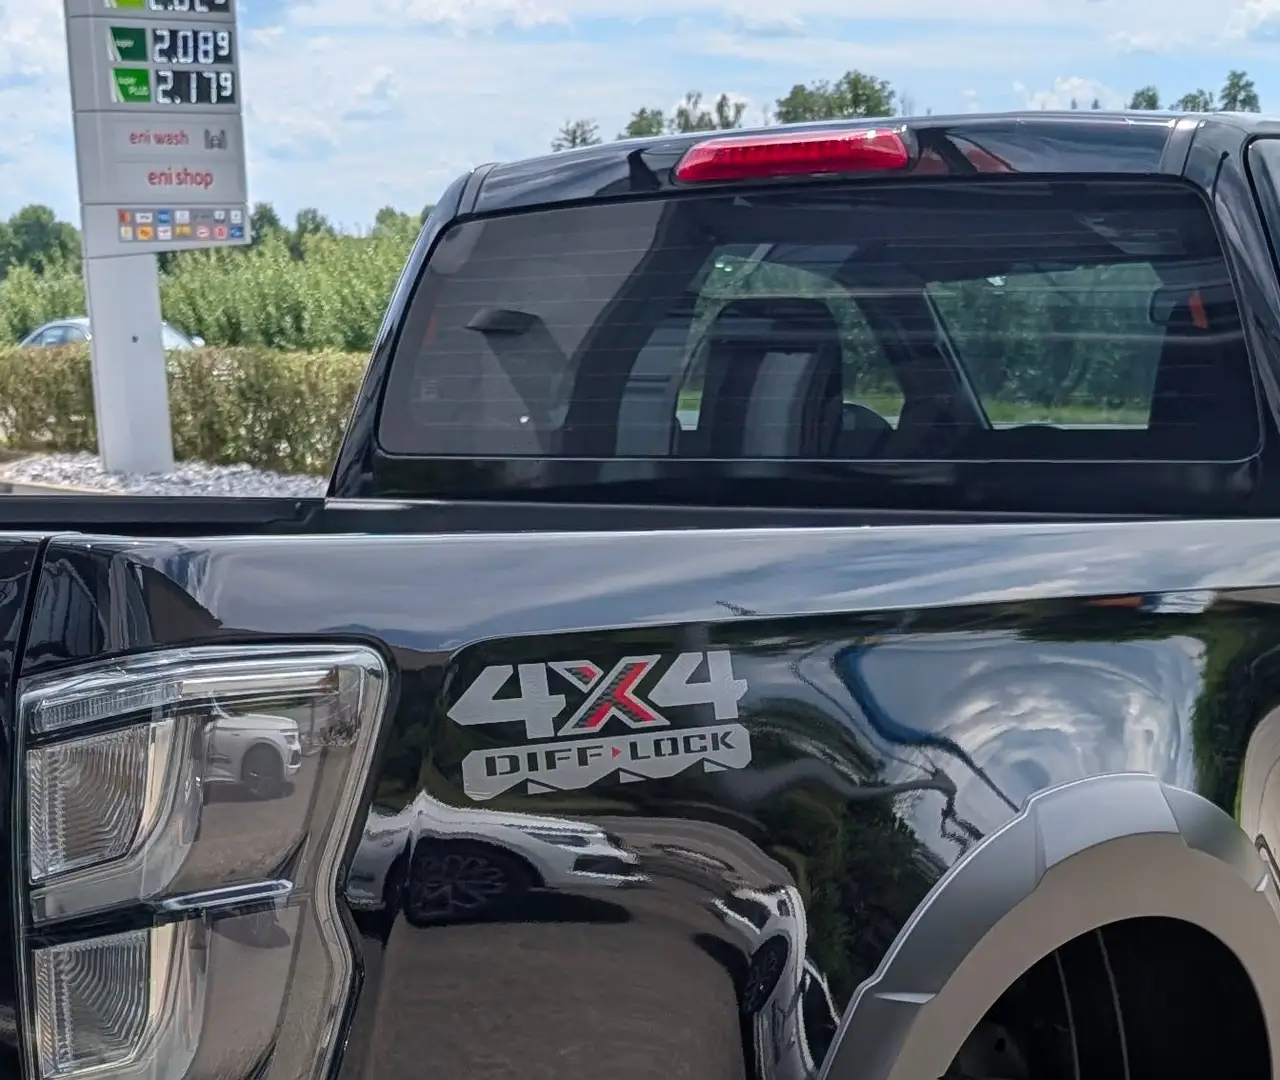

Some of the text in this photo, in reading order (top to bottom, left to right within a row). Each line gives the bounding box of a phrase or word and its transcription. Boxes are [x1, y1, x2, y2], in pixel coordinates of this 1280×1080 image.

[129, 130, 189, 146] eni wash
[148, 166, 213, 190] eni shop
[485, 731, 737, 777] DIFF LOCK
